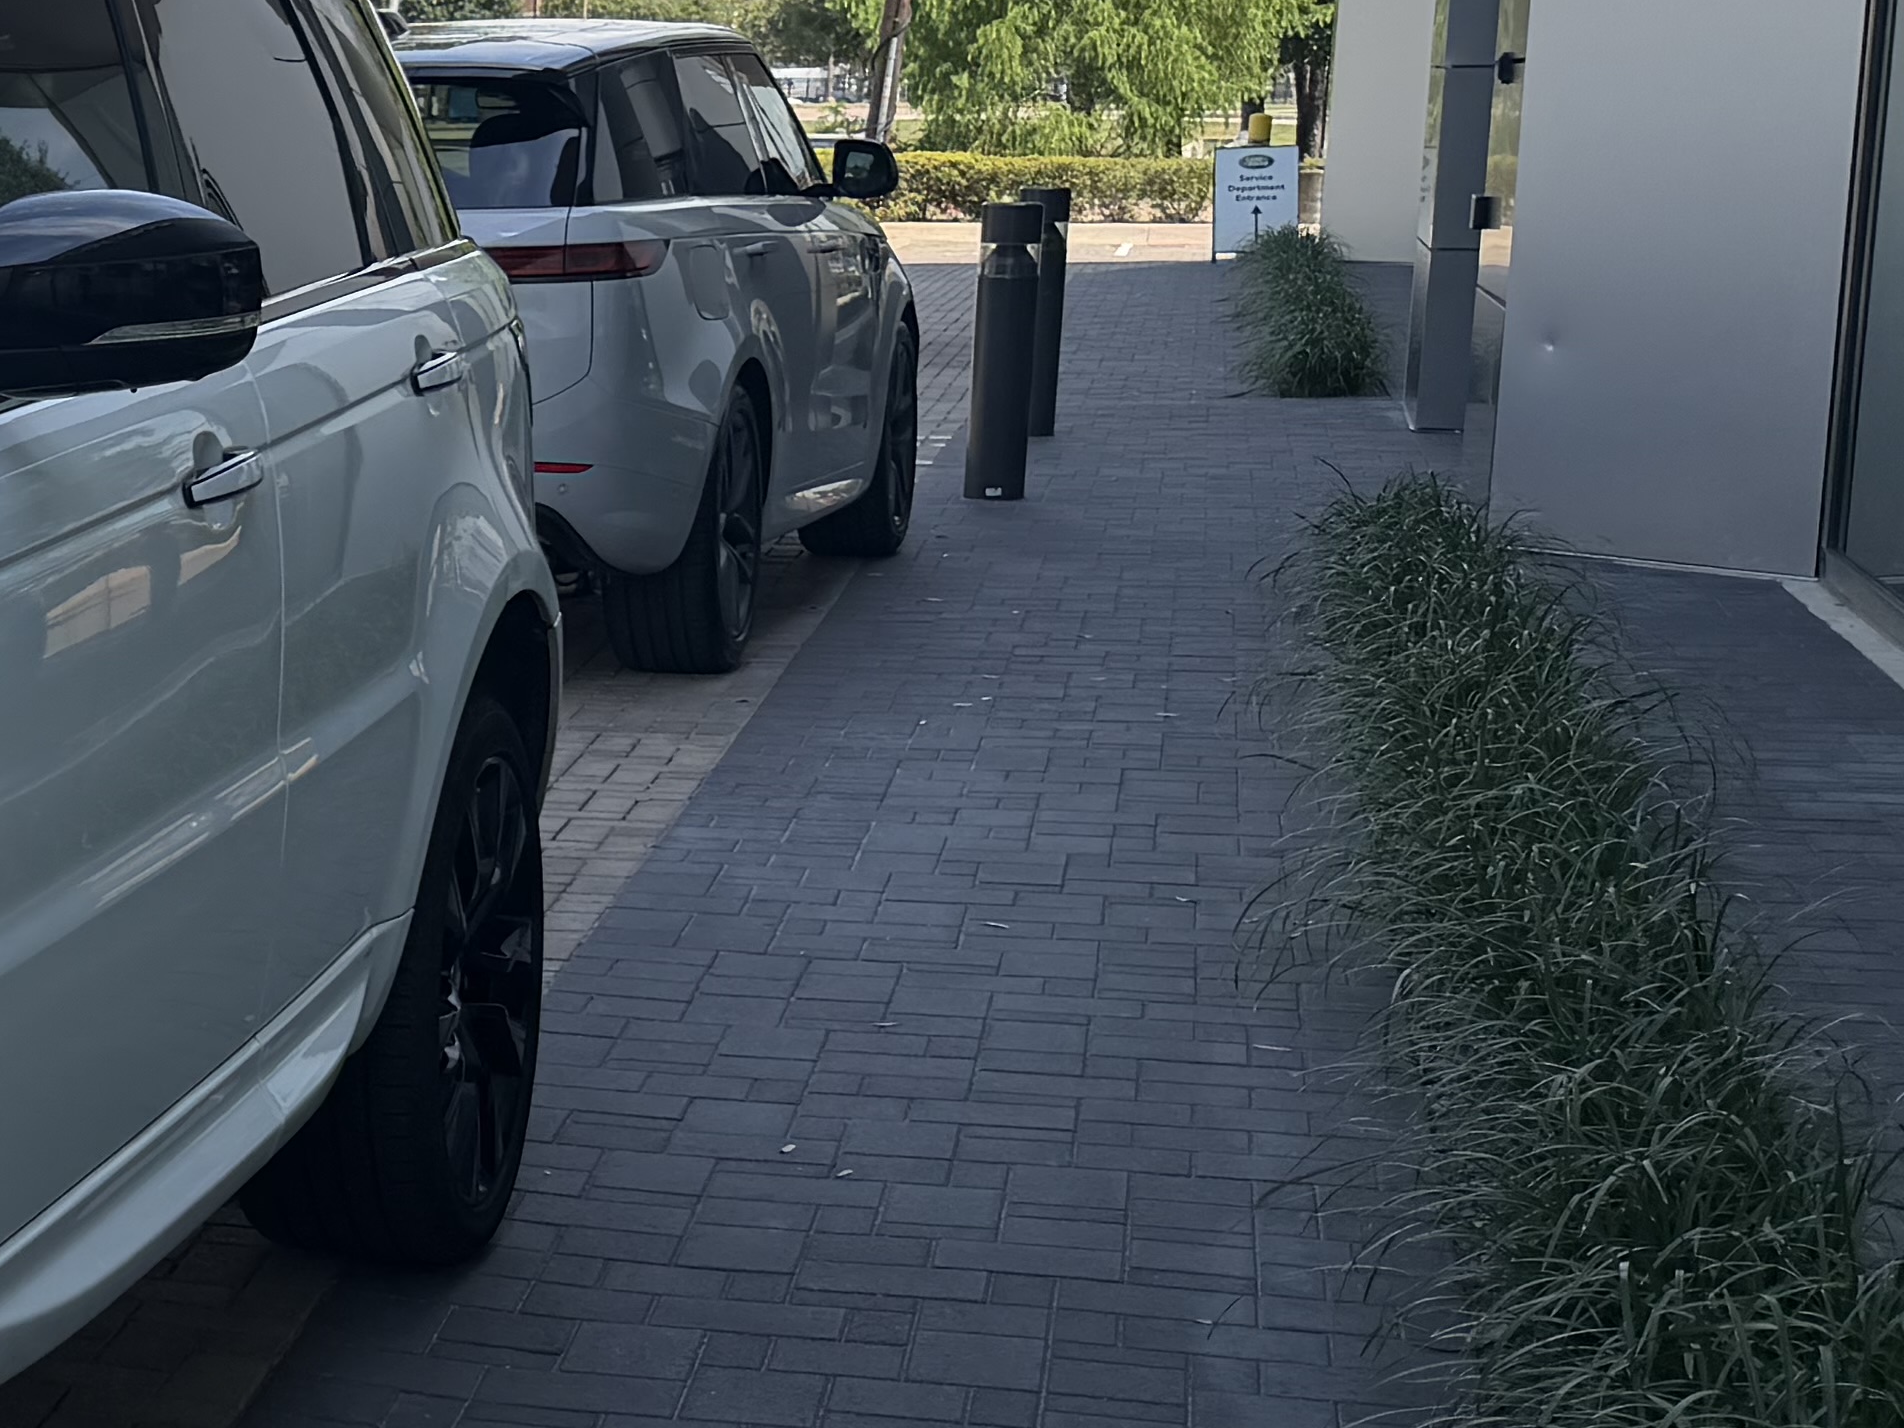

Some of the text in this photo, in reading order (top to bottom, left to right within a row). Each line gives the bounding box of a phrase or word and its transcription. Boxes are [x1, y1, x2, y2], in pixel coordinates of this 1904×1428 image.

[1239, 174, 1274, 182] Service
[1227, 184, 1285, 193] Department
[1235, 194, 1277, 202] Entrance
